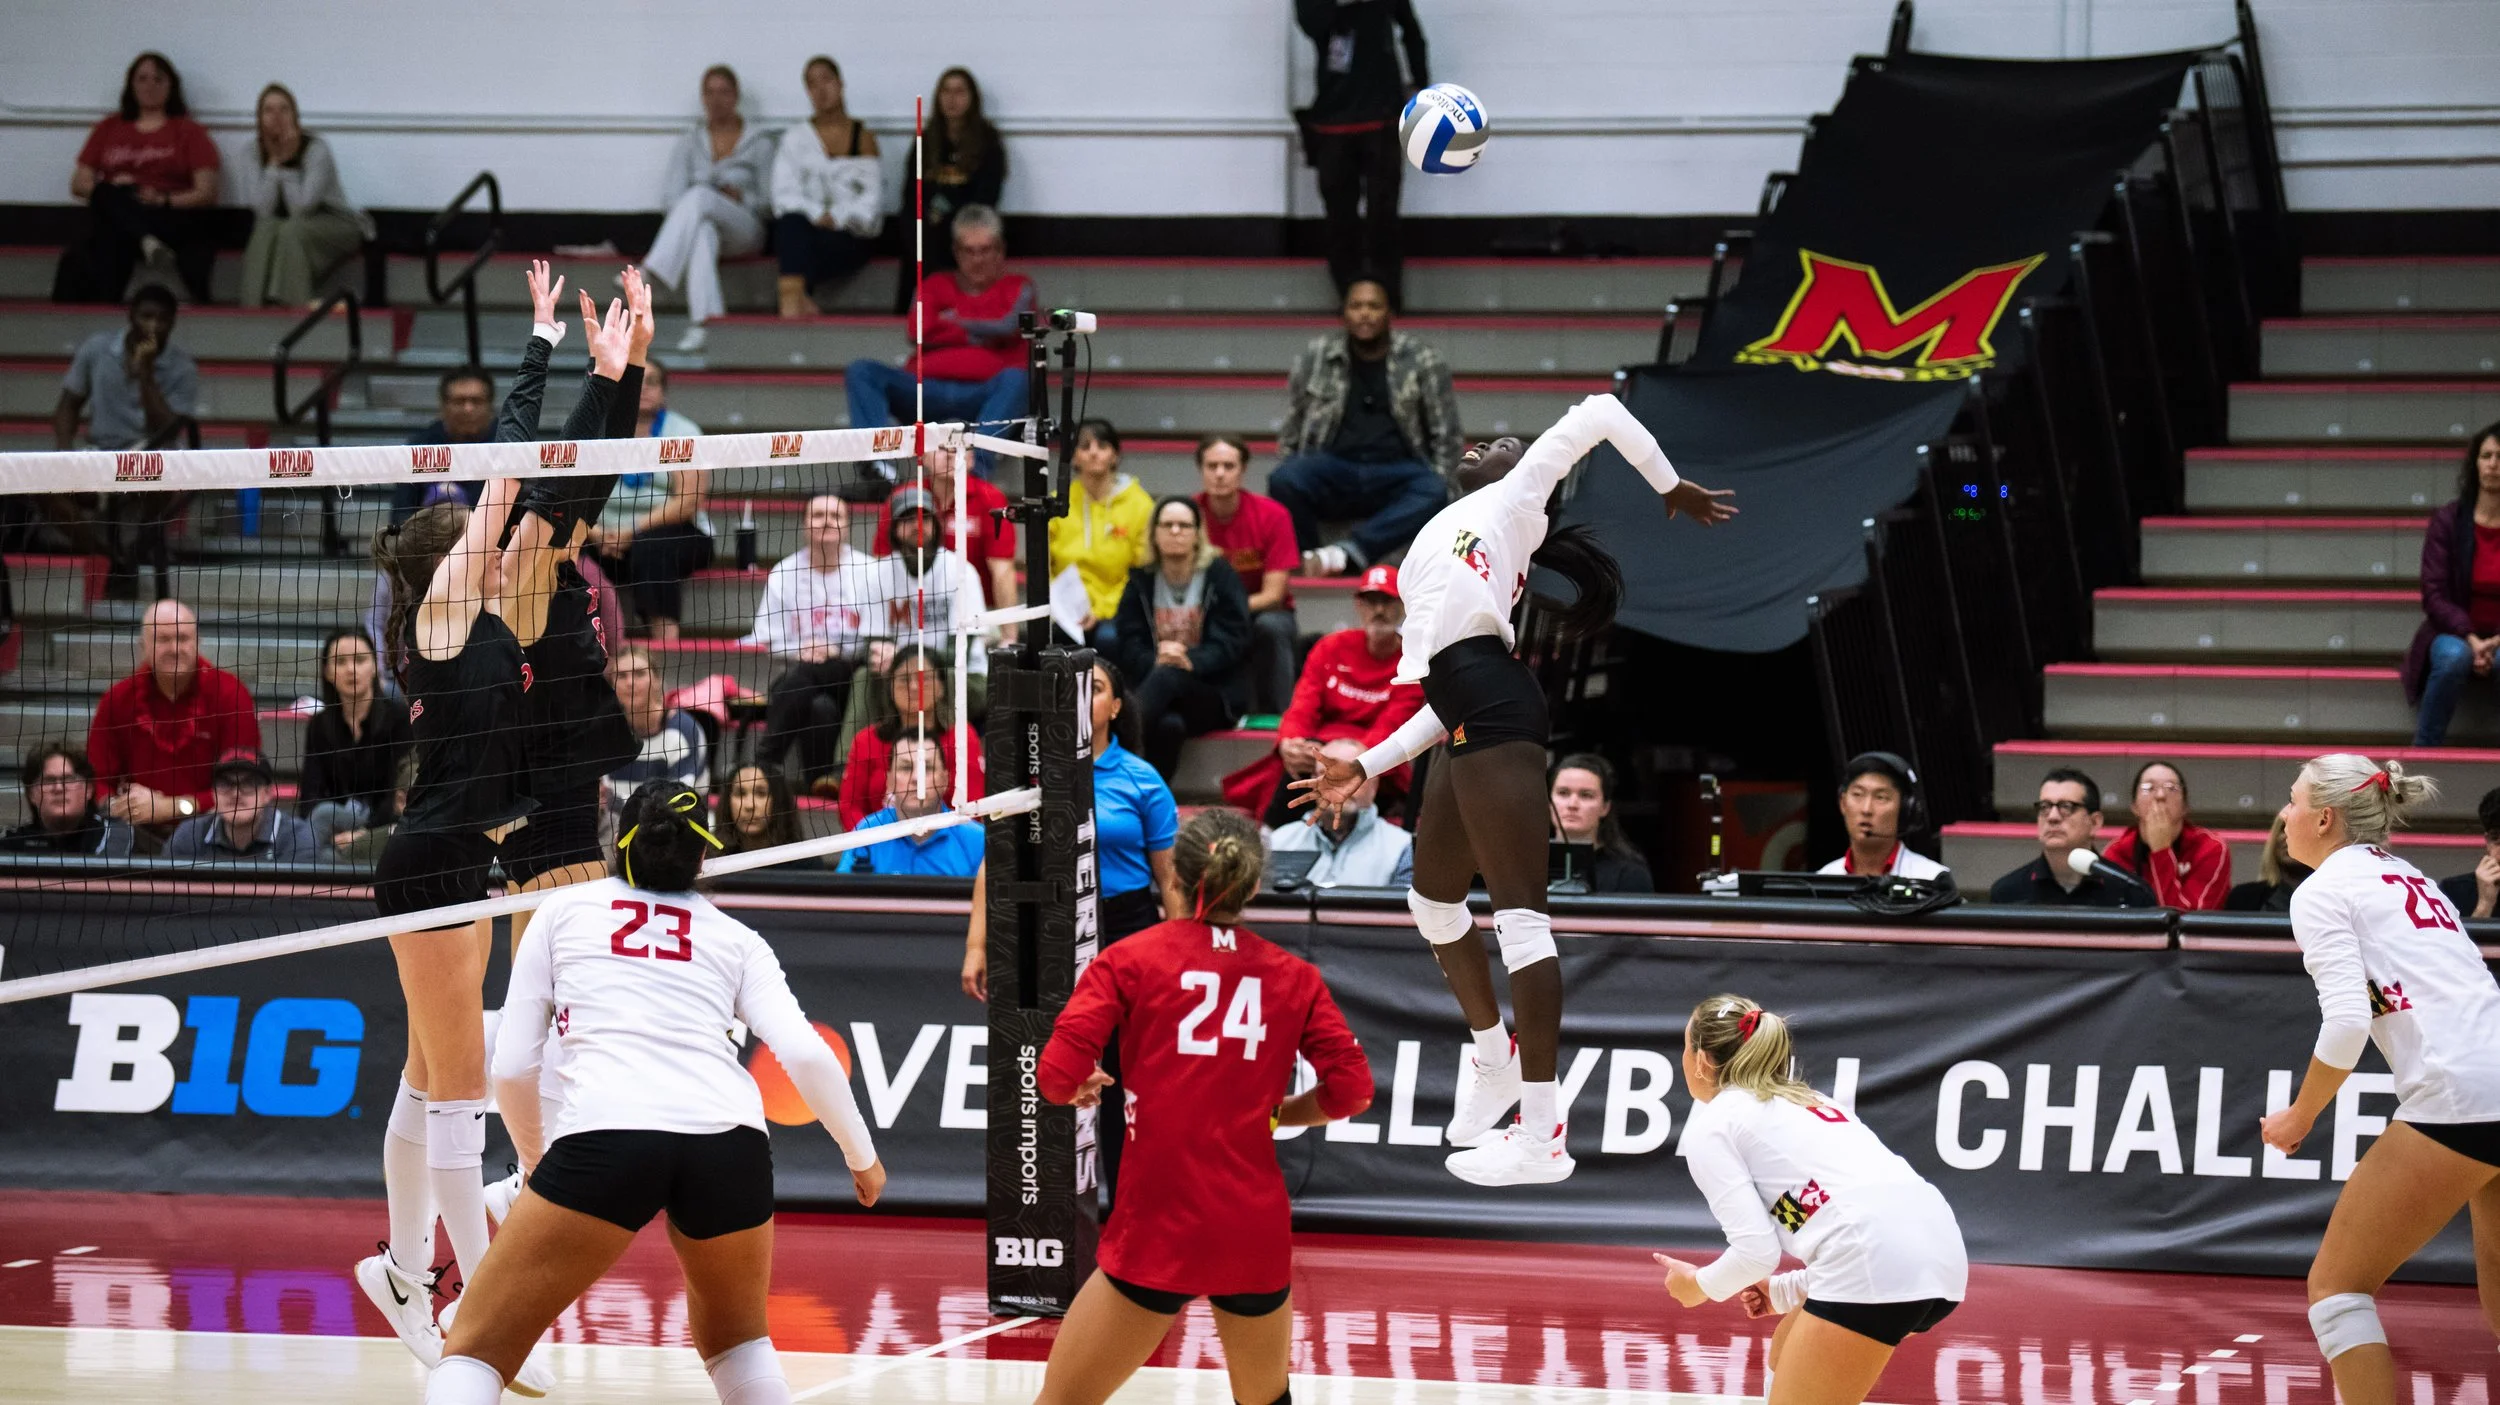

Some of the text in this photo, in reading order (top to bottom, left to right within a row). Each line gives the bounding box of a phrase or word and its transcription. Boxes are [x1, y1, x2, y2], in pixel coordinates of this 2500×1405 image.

[115, 453, 164, 476] MARYLAND
[269, 450, 314, 473] MARYLAND
[411, 446, 452, 469] MARYLAND
[540, 442, 578, 464] MARYLAND
[1027, 722, 1042, 776] sports
[2381, 873, 2460, 933] 26
[610, 899, 693, 962] 23
[1211, 925, 1238, 951] M
[1177, 969, 1268, 1062] 24
[1016, 1044, 1041, 1206] sports imports
[1934, 1059, 2401, 1182] CHALLE
